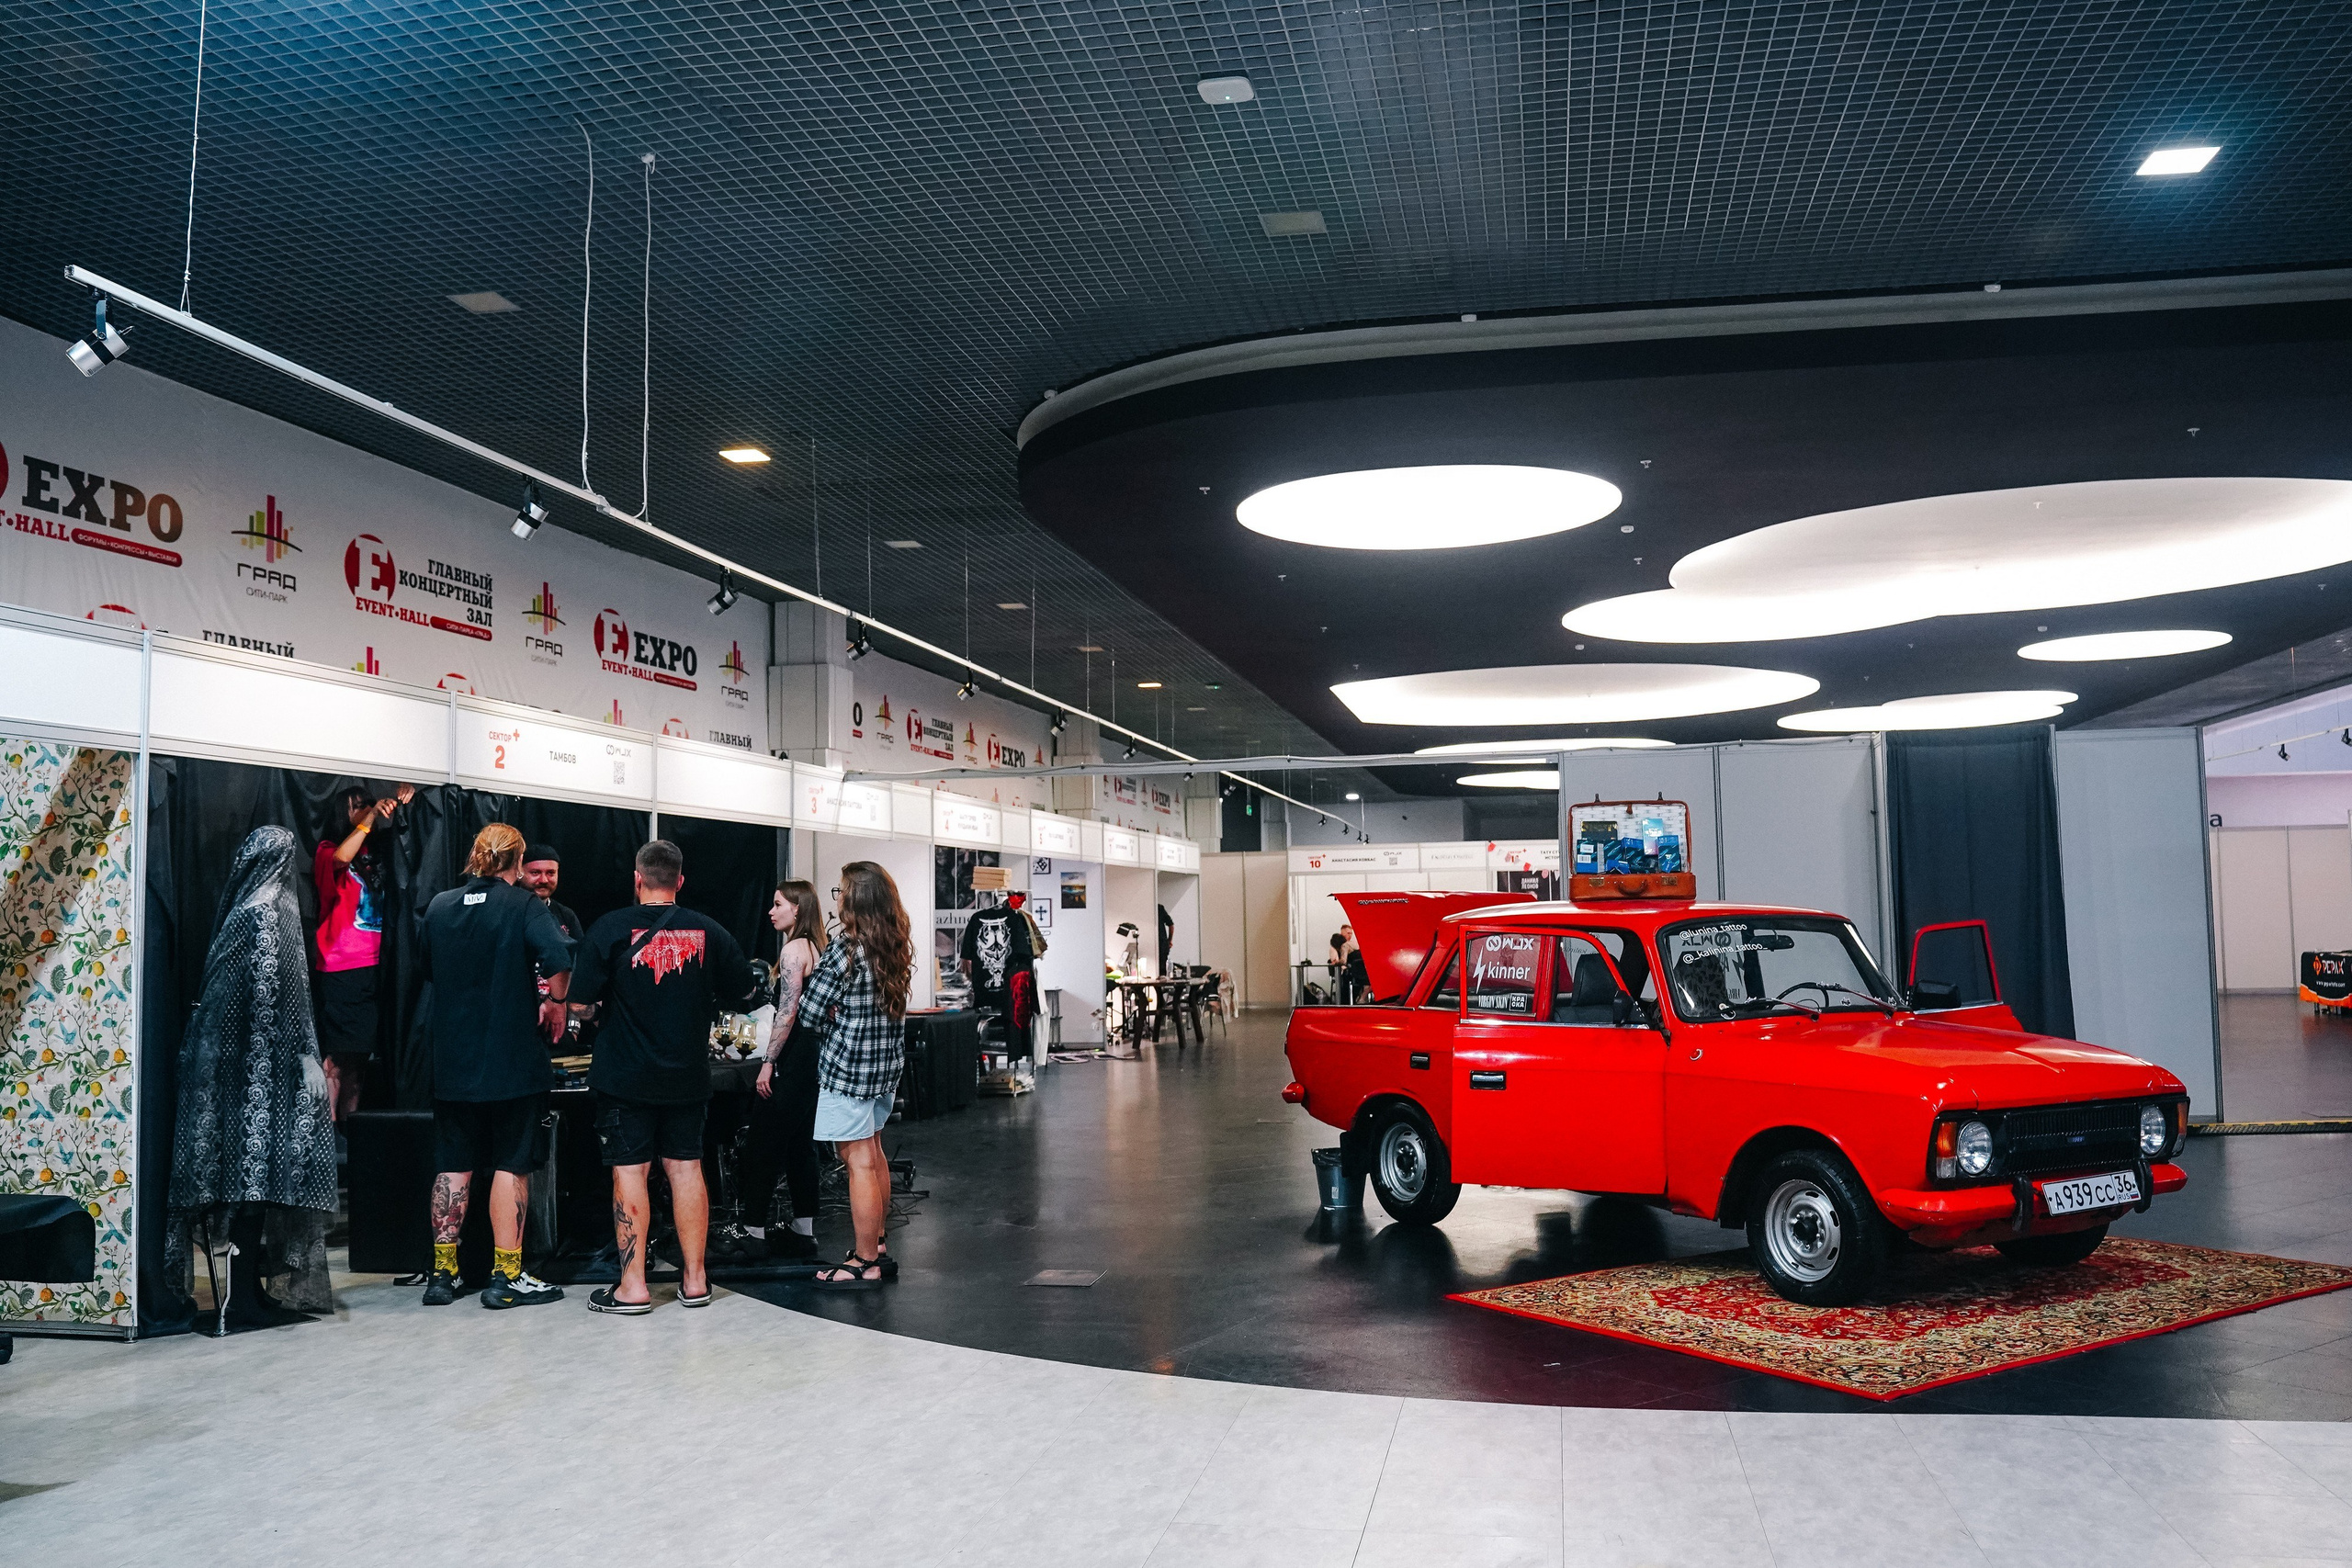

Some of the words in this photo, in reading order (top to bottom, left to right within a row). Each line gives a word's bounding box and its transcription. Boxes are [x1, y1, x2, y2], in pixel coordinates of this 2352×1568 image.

[22, 455, 183, 543] EXPO
[237, 562, 297, 592] ГРАД
[428, 559, 492, 592] ГЛАВНЫЙ
[246, 587, 288, 604] СИТИ-ПАРК
[399, 570, 492, 609] КОНЦЕРТНЫЙ
[467, 607, 492, 626] ЗАЛ
[526, 636, 562, 657] ГРАД
[634, 631, 697, 676] EXPO
[721, 685, 749, 701] ГРАД
[489, 731, 512, 742] СЕКТОР
[709, 730, 752, 750] ГЛАВНЫЙ
[876, 732, 894, 743] ГРАД
[495, 745, 505, 769] 2
[549, 750, 577, 764] ТАМБОВ
[1001, 746, 1025, 768] EXPO
[811, 797, 817, 814] 3
[1309, 860, 1320, 868] 10
[1679, 924, 1747, 941] @lunina_tattoo
[1683, 942, 1768, 964] @_kalinina_tattoo_
[2322, 960, 2344, 975] PEPAX
[2115, 1174, 2132, 1193] 36
[2119, 1192, 2131, 1201] RUS
